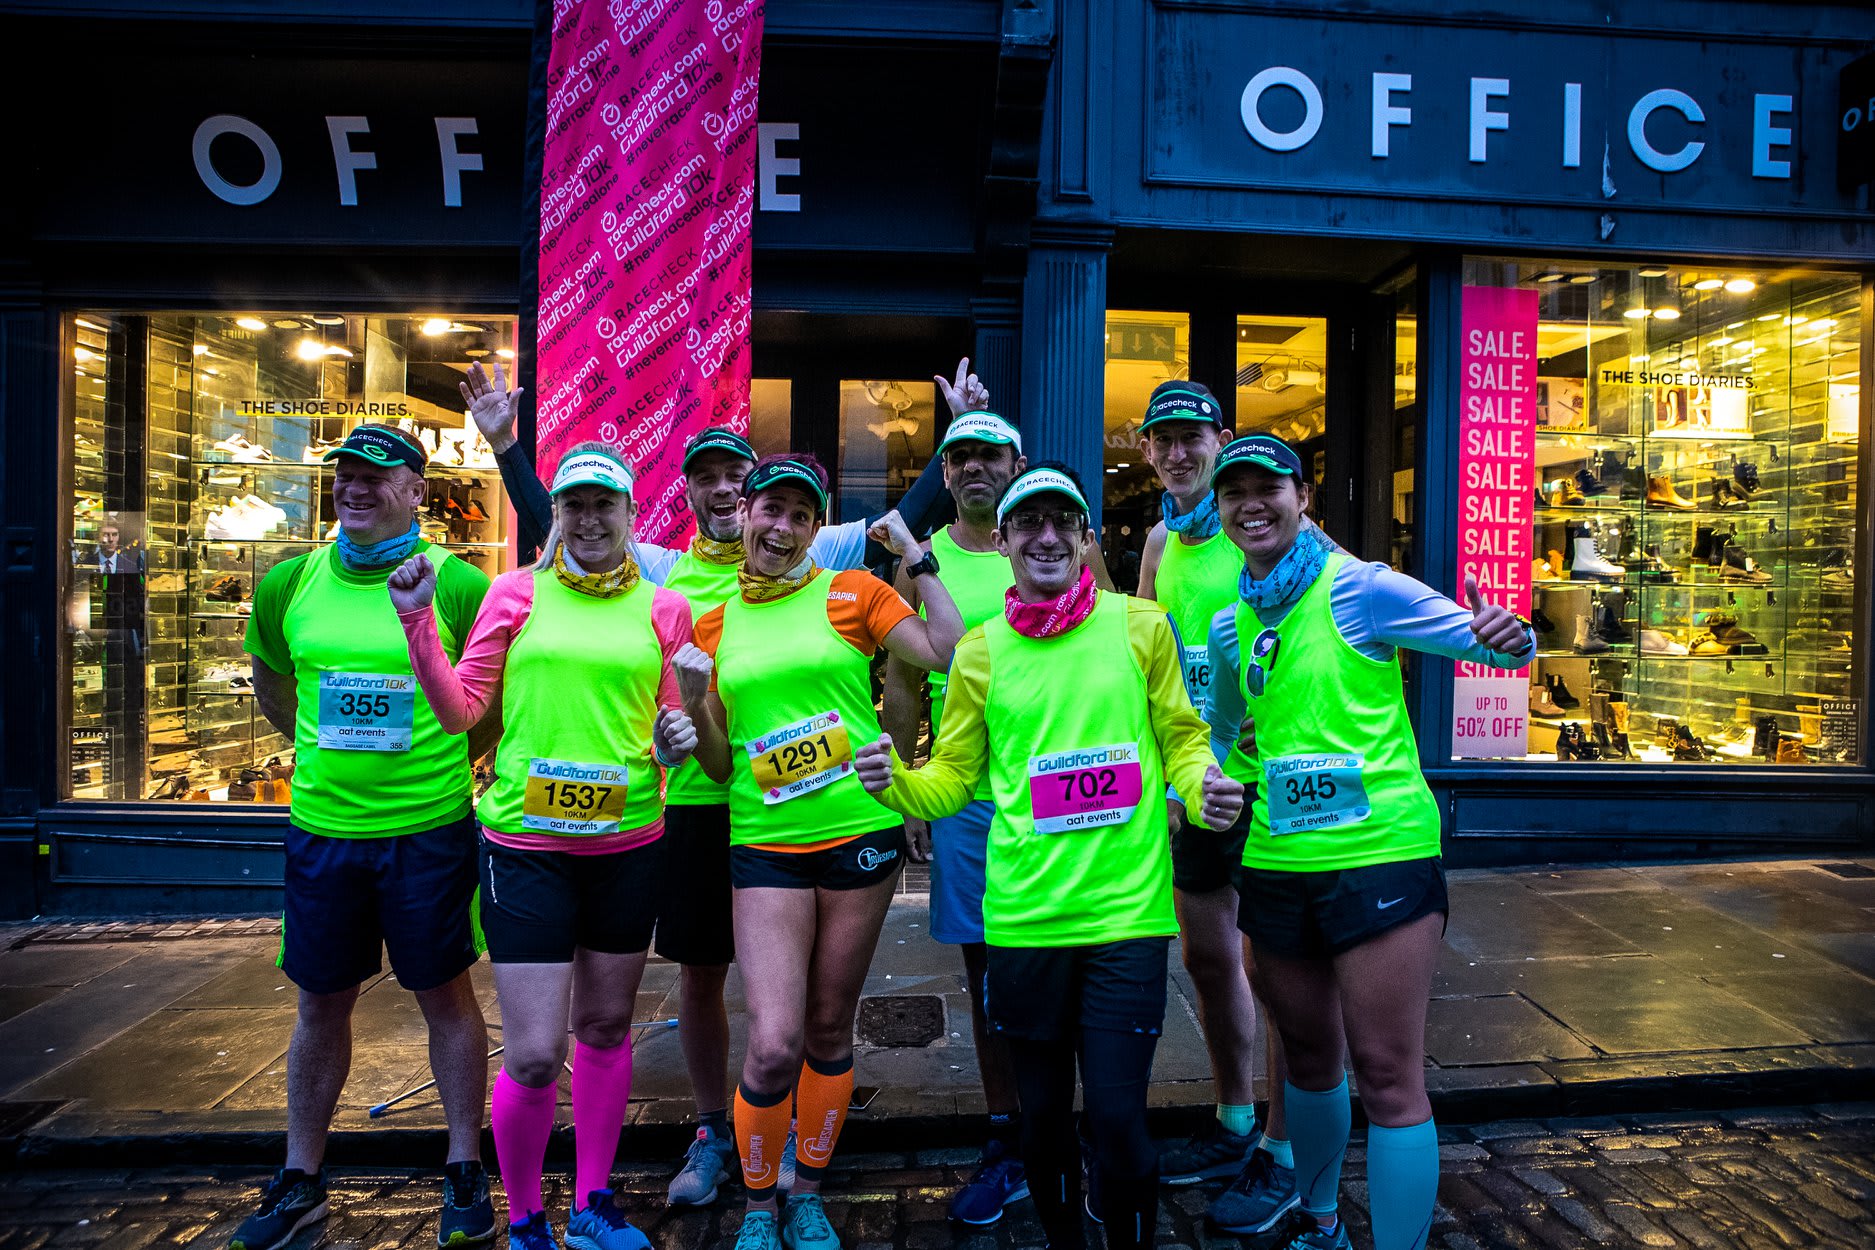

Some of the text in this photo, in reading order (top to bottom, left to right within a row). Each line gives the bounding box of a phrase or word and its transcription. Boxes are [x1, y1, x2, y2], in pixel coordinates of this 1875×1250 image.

[619, 24, 697, 107] RACECHECK
[610, 42, 707, 141] racecheck.com
[1240, 66, 1793, 179] OFFICE
[616, 137, 695, 214] RACECHECK
[607, 153, 706, 247] racecheck.com
[613, 247, 698, 321] RACECHECK
[1602, 370, 1634, 384] THE
[1639, 371, 1684, 386] SHOE
[241, 400, 275, 414] THE
[281, 401, 330, 415] SHOE
[1157, 399, 1197, 410] racecheck
[1228, 443, 1276, 459] racecheck
[569, 460, 614, 473] racecheck
[1026, 477, 1075, 491] RACECHECK
[339, 692, 390, 718] 355
[1476, 696, 1508, 711] UP TO
[72, 731, 110, 739] OFFICE
[338, 728, 386, 737] aat events
[755, 716, 835, 753] uildford10k
[1456, 717, 1524, 738] 50% OFF
[389, 742, 403, 750] 355
[768, 734, 832, 776] 1291
[795, 765, 817, 778] 10KM
[788, 770, 832, 794] aat events
[1057, 768, 1119, 801] 702
[1285, 772, 1337, 805] 345
[544, 782, 612, 810] 1537
[1080, 800, 1105, 810] 10KM
[1300, 803, 1322, 813] 10KM
[563, 810, 587, 819] 10KM
[1066, 810, 1121, 826] aat events
[1290, 812, 1340, 828] aat events
[550, 820, 598, 831] aat events
